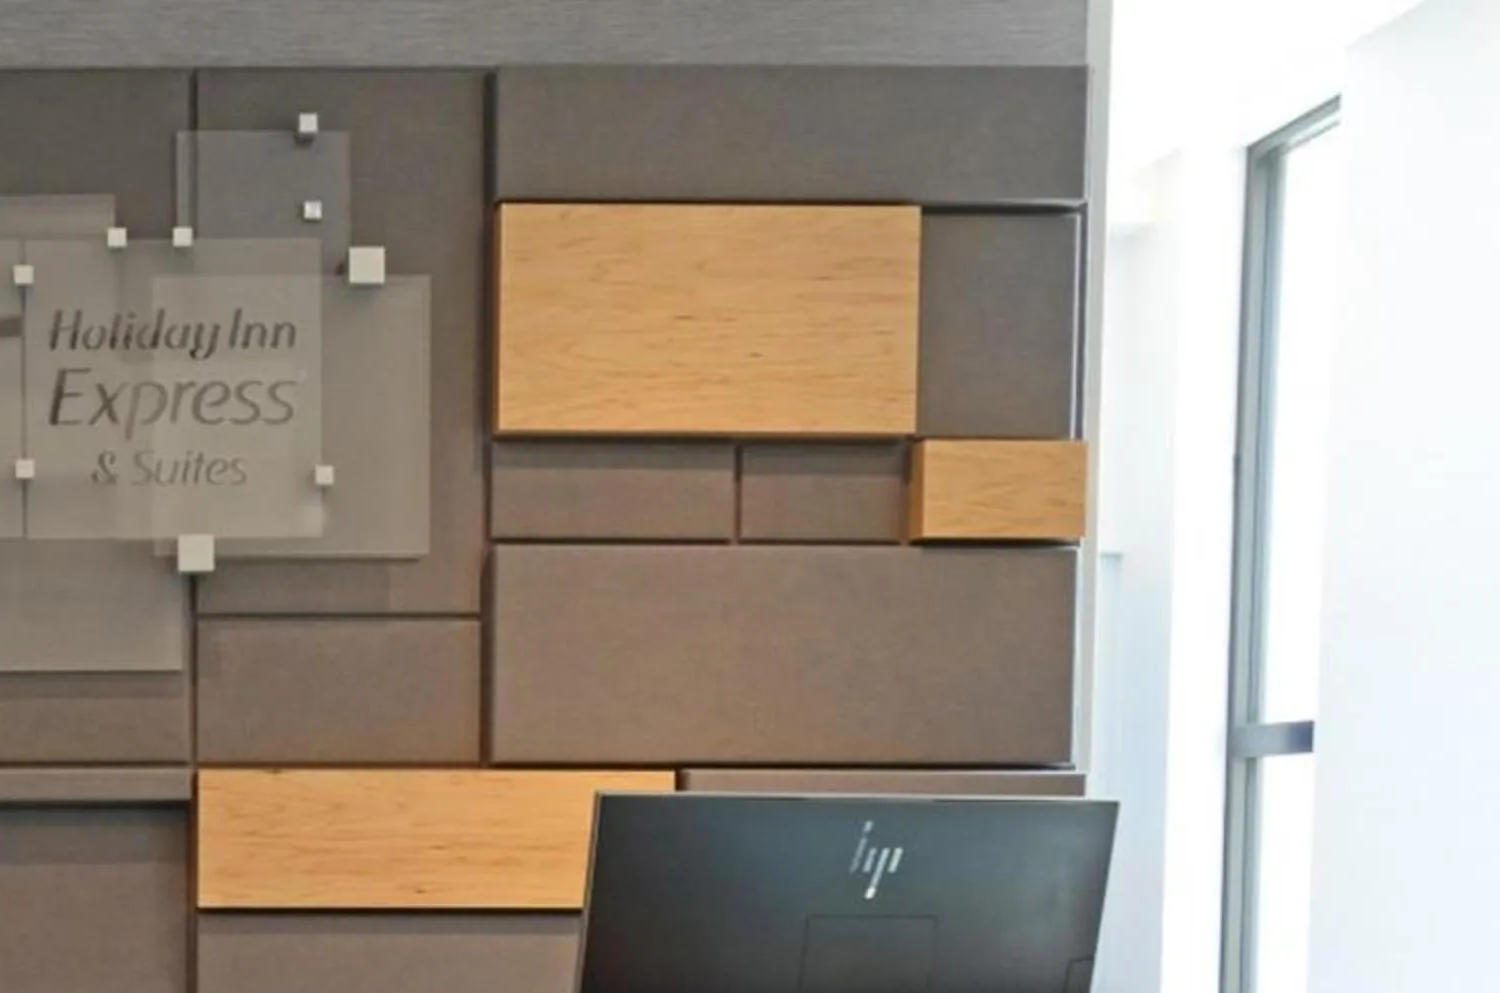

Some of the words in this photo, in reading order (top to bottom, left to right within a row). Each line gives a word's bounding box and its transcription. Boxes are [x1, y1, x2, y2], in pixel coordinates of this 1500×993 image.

[48, 308, 220, 360] Holiday
[229, 306, 297, 350] Inn
[48, 367, 298, 441] Express
[90, 450, 119, 485] &
[132, 450, 248, 487] Suites
[849, 820, 903, 900] hp
